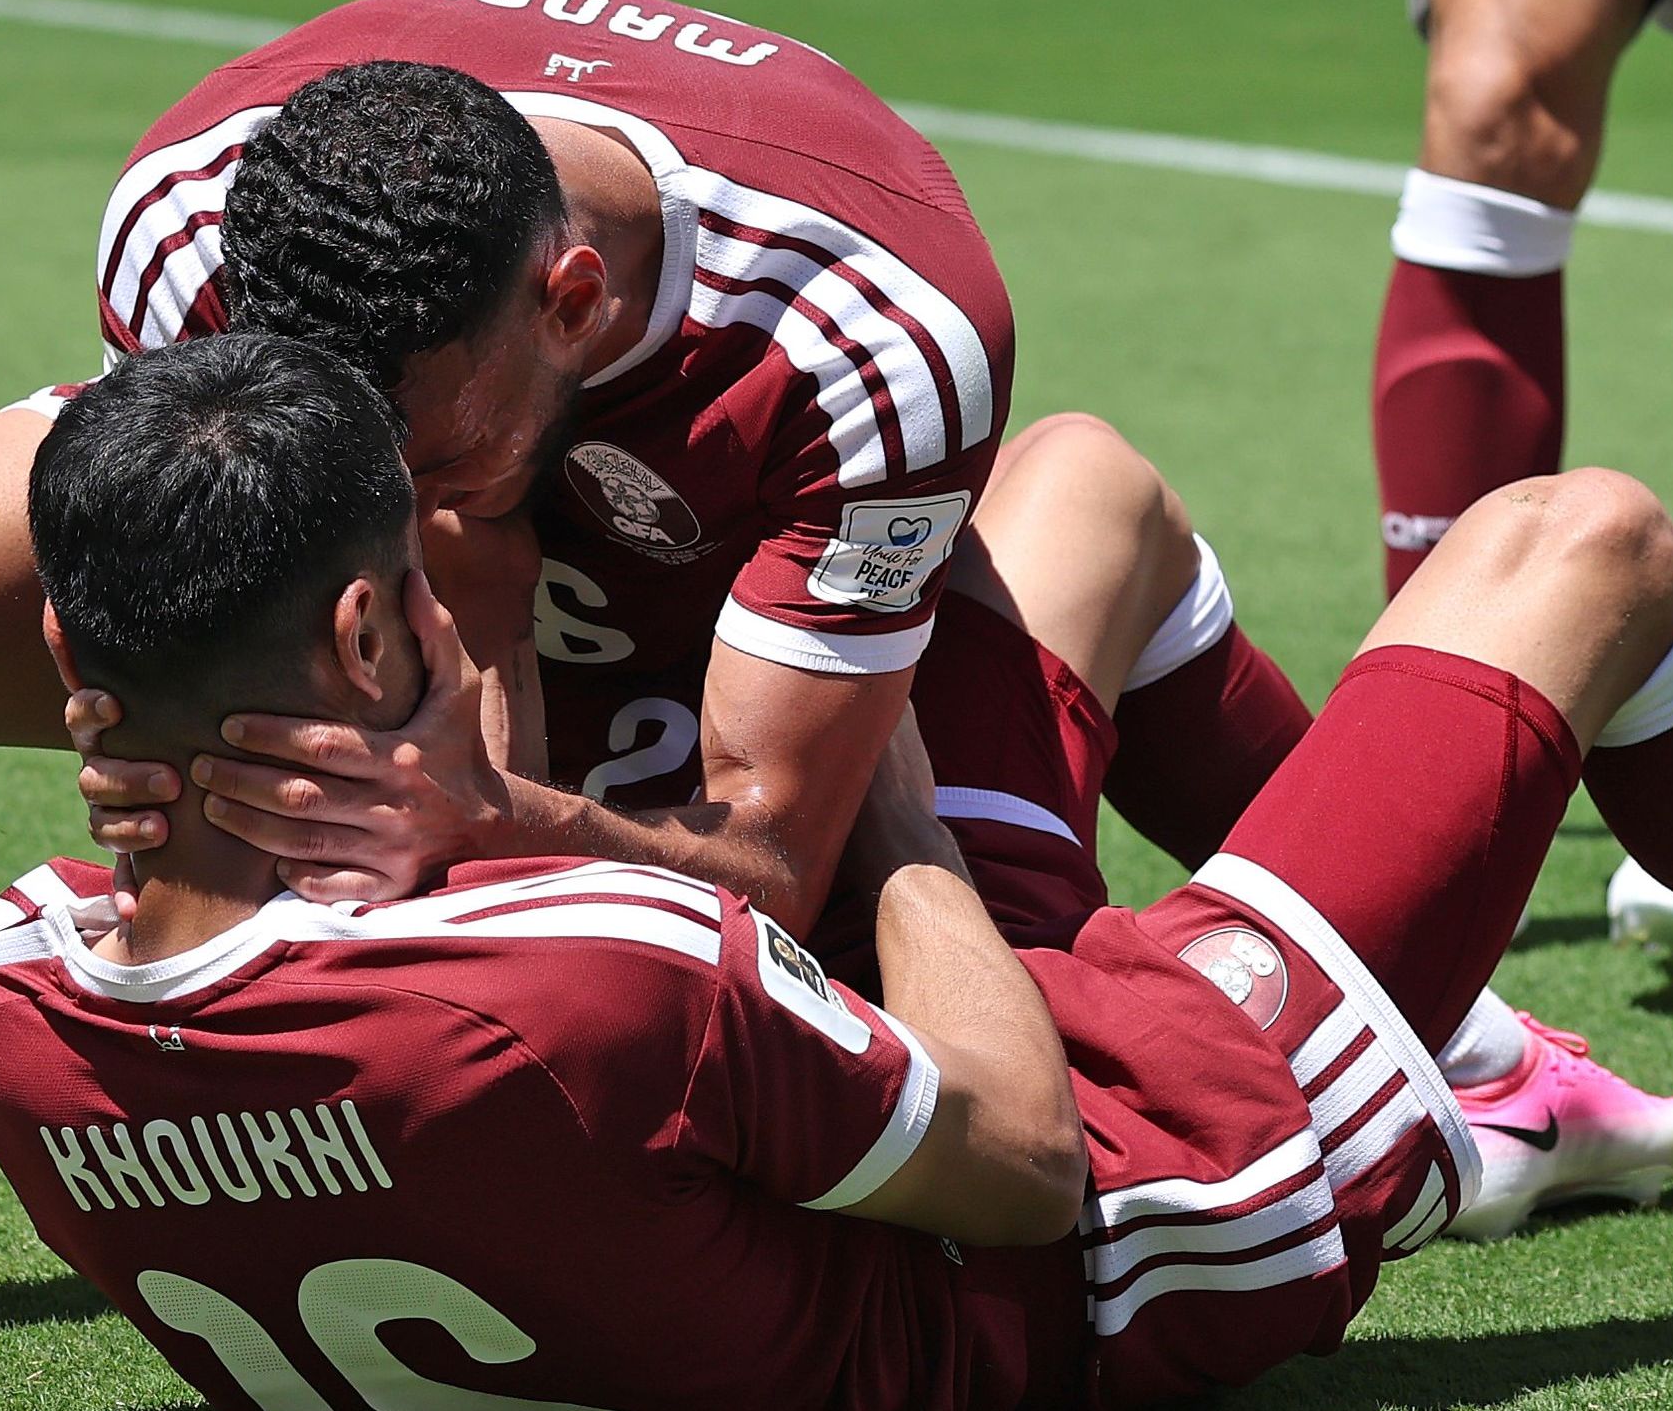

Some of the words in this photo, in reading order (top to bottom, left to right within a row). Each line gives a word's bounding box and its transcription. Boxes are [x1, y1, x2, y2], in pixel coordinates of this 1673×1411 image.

[612, 515, 677, 546] QFA
[1381, 510, 1455, 550] QF
[39, 1099, 393, 1213] KHOUKHI
